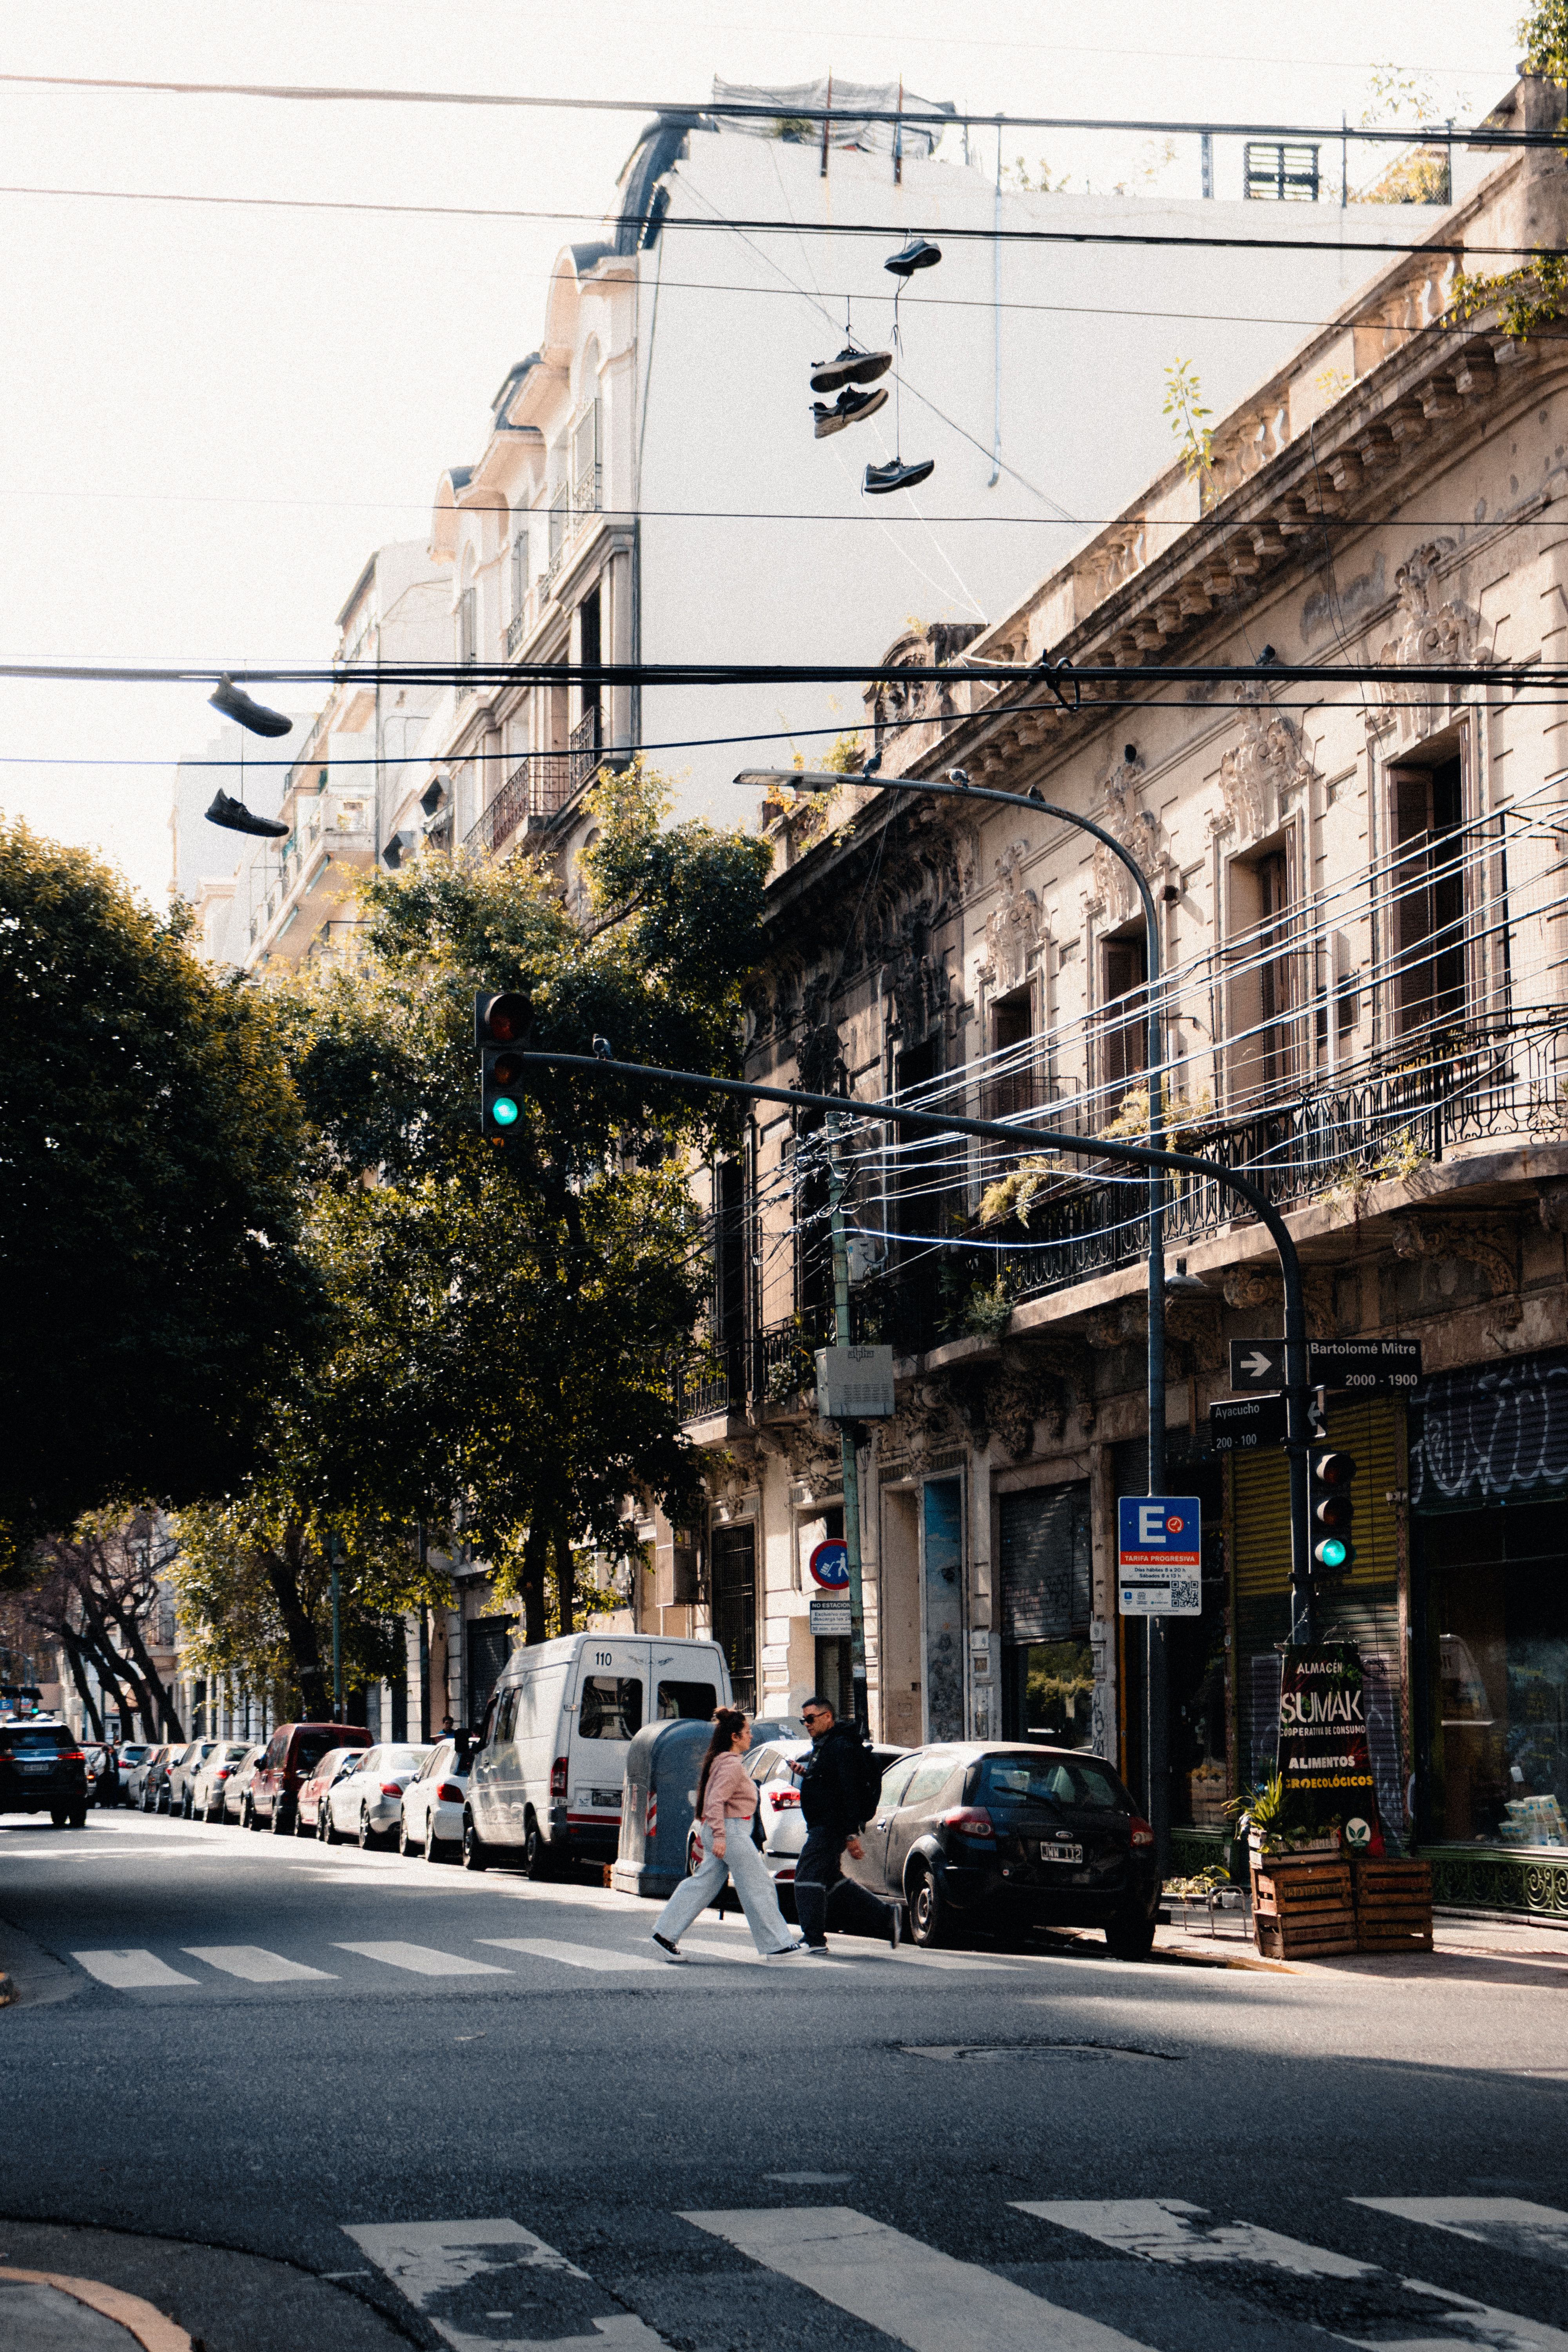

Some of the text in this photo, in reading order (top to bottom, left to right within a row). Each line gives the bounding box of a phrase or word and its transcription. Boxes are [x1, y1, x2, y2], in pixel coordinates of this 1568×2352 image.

[848, 1347, 874, 1362] alpha
[1310, 1342, 1416, 1355] Bartolomé Mitre
[1345, 1374, 1376, 1386] 2000
[1388, 1374, 1418, 1386] 1900
[1215, 1403, 1259, 1420] Ayacucho
[1216, 1438, 1232, 1448] 200
[1241, 1434, 1257, 1446] 100
[1139, 1506, 1166, 1543] E
[595, 1651, 612, 1666] 110
[1297, 1660, 1343, 1674] ALMACÉN
[1281, 1690, 1364, 1723] SUMAK
[1279, 1725, 1366, 1737] COOPERATIVA DE CONSUMO
[1289, 1755, 1356, 1769] ALIMENTOS
[1065, 1847, 1081, 1860] 112
